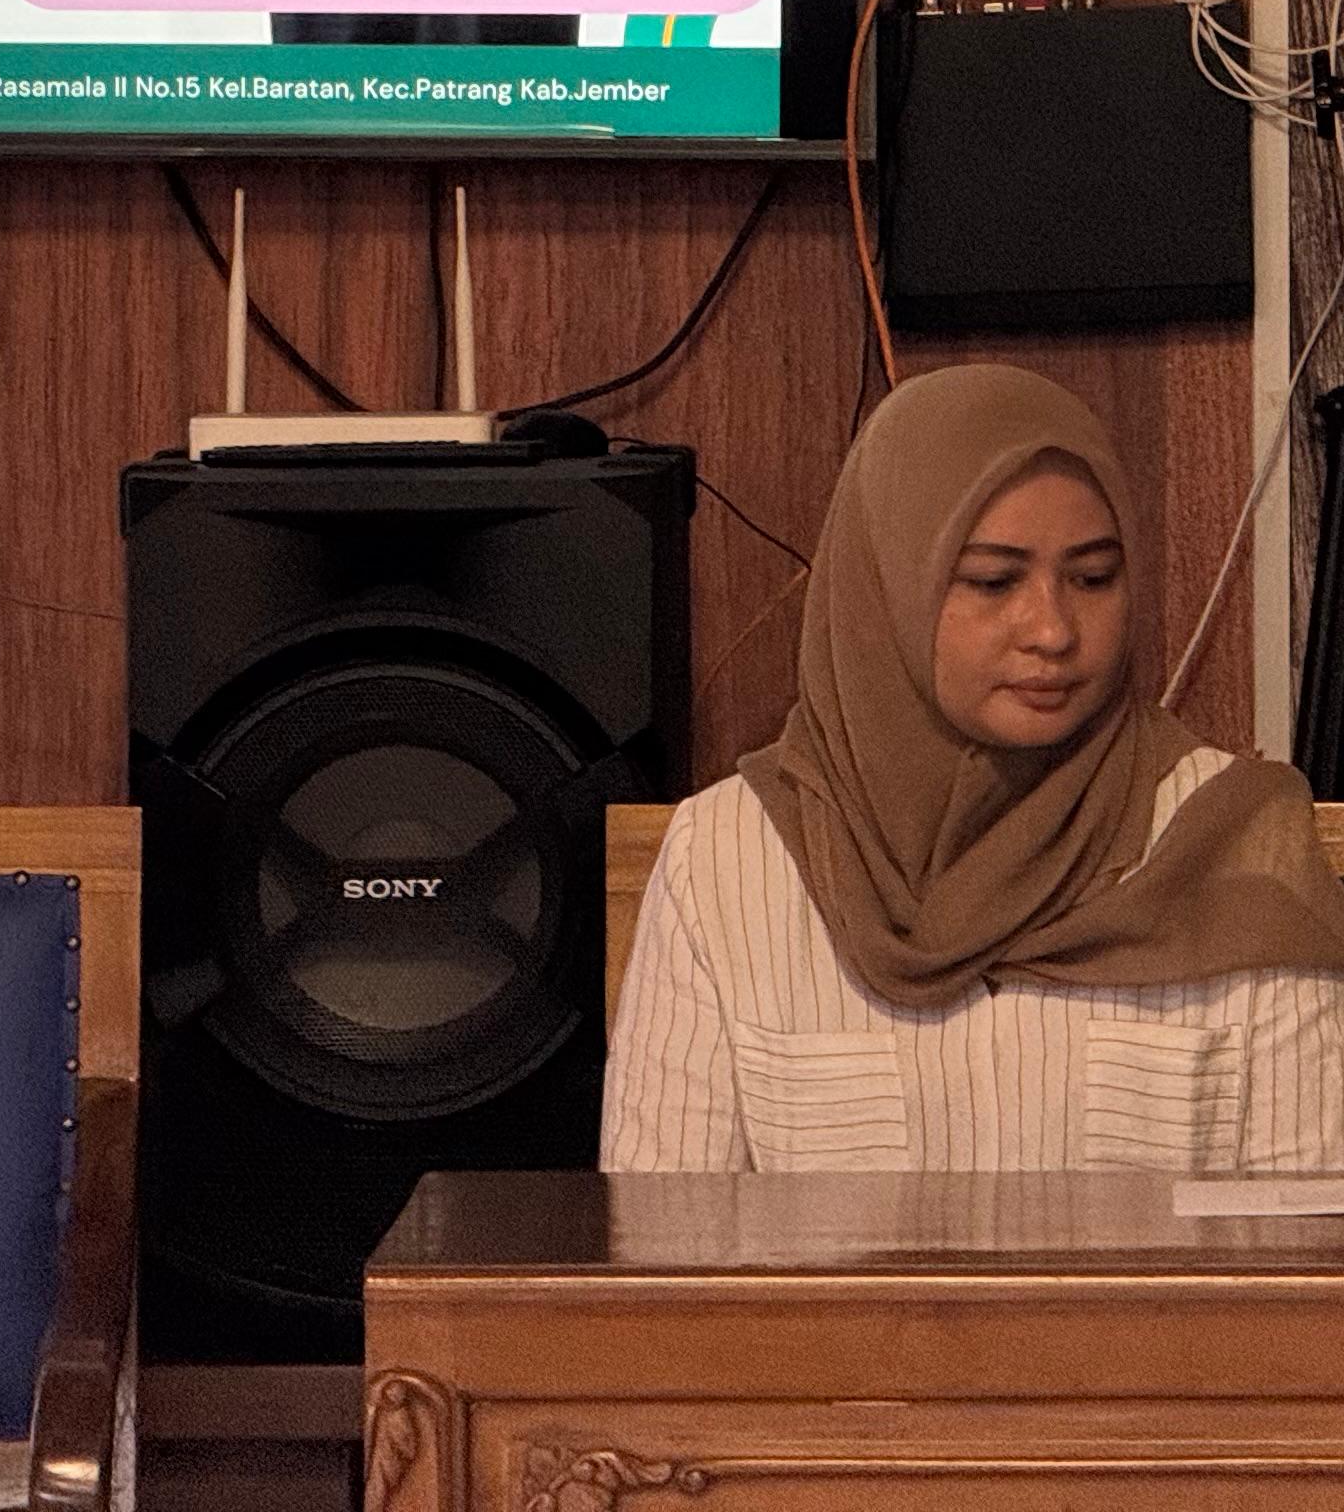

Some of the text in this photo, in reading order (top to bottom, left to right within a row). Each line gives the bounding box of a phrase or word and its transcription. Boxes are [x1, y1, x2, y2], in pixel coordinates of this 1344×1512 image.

[114, 76, 127, 98] II
[135, 76, 201, 99] No.15
[209, 76, 355, 102] Kel.Baratan,
[363, 77, 513, 107] Kec.Patrang
[520, 77, 671, 102] Kab.Jember
[343, 878, 443, 899] SONY
